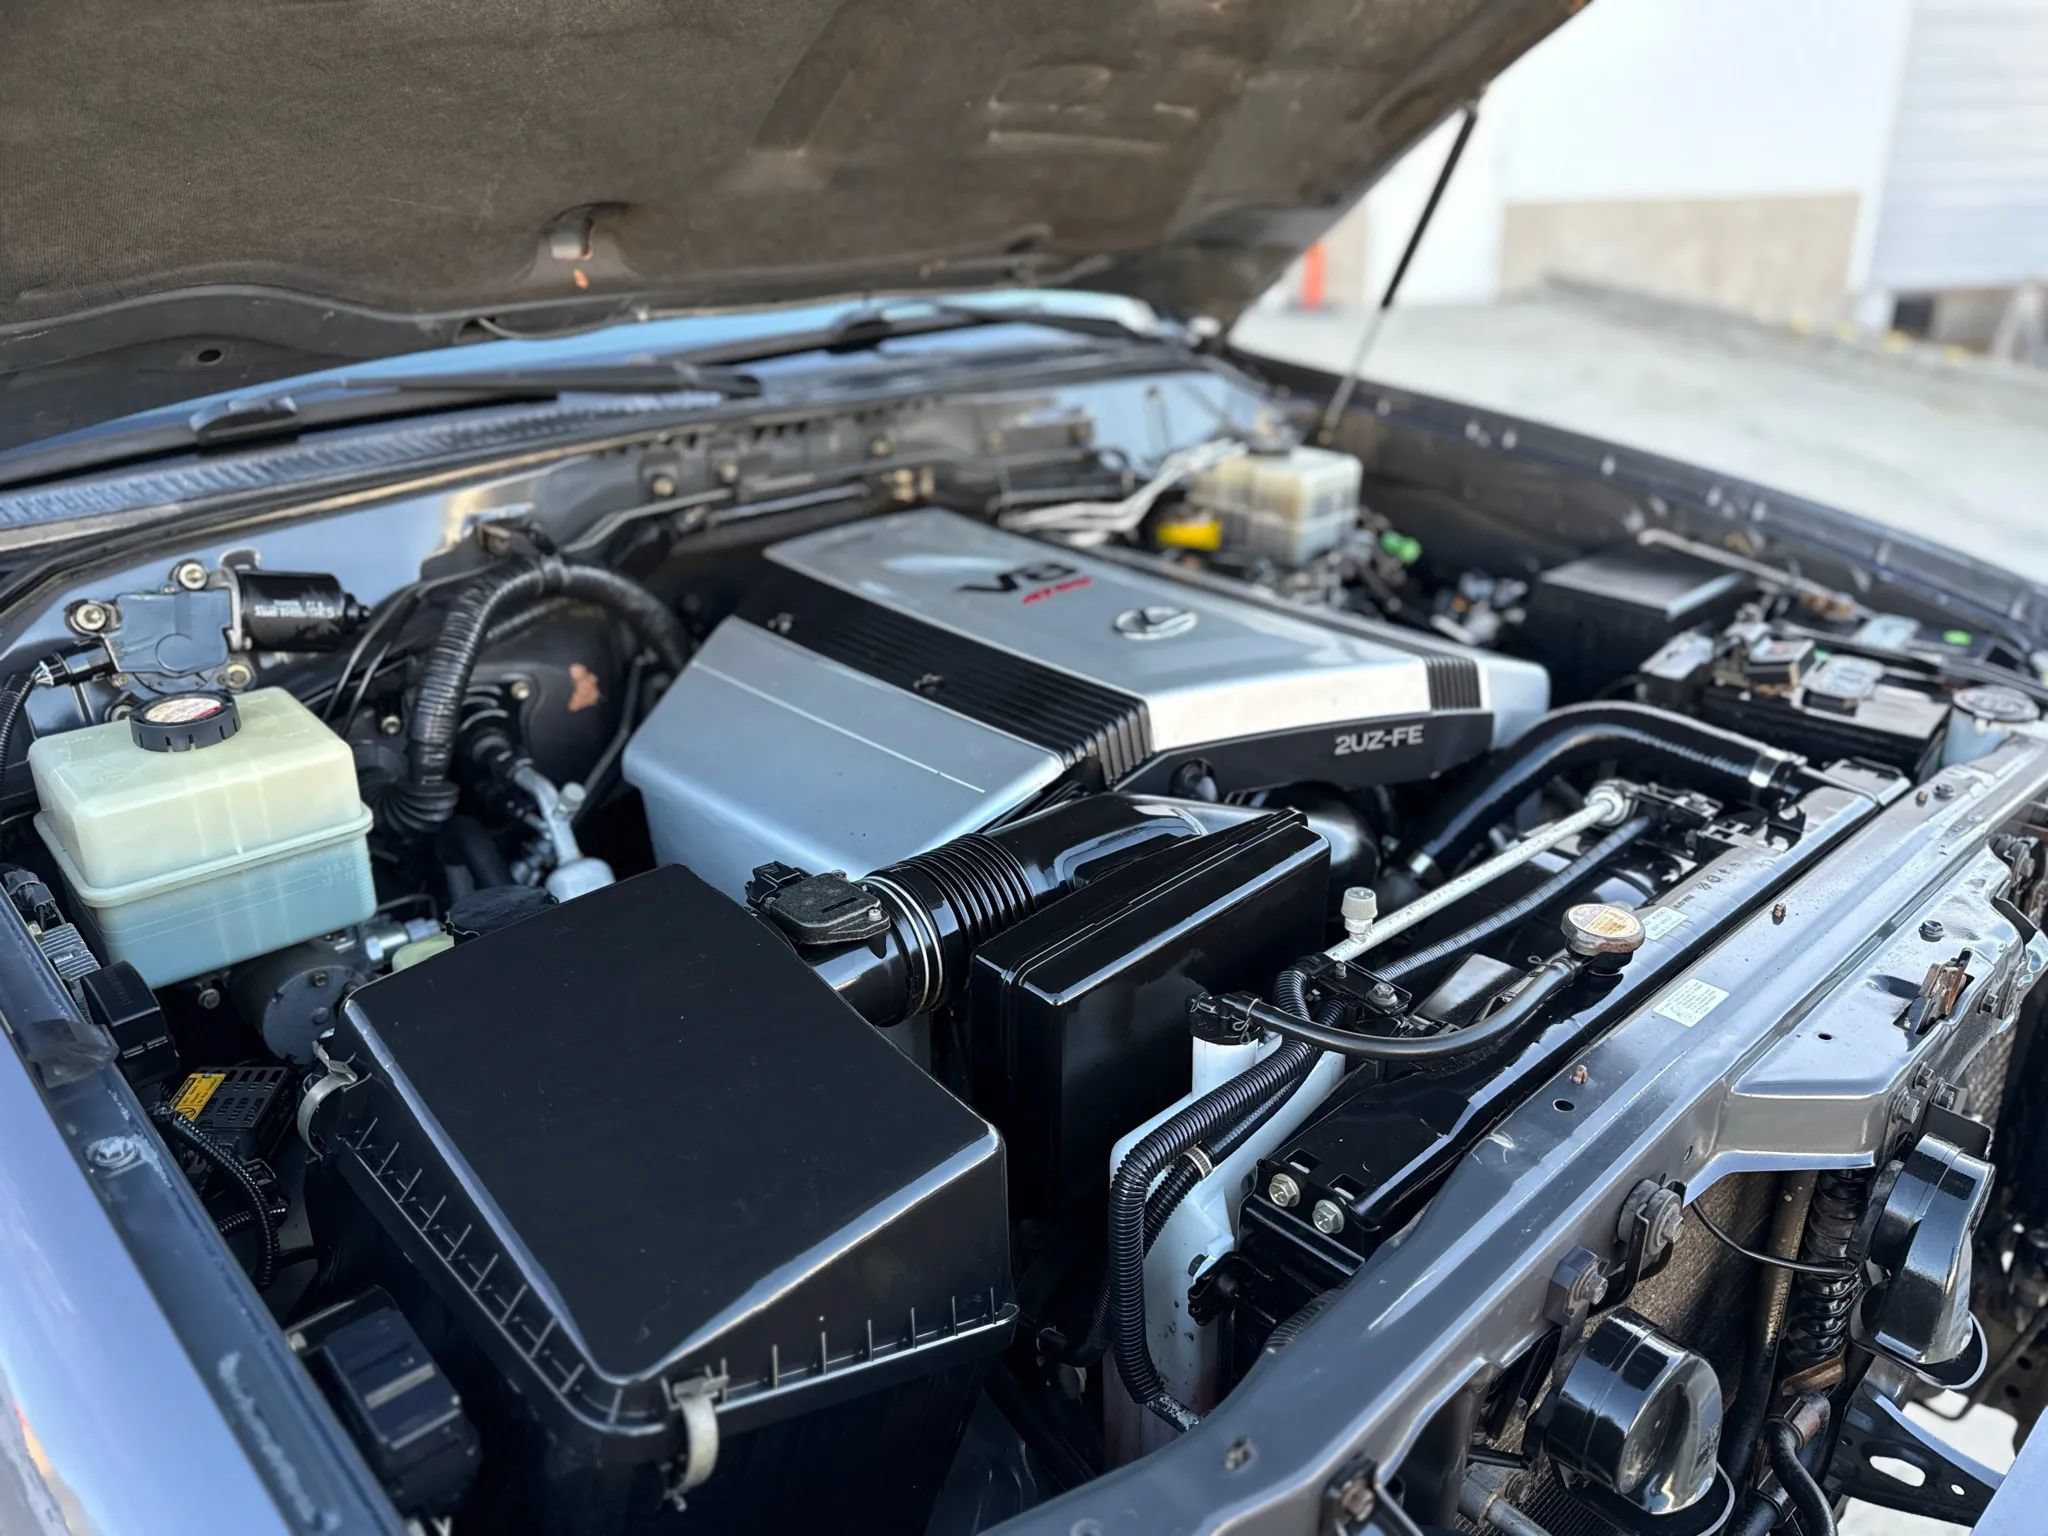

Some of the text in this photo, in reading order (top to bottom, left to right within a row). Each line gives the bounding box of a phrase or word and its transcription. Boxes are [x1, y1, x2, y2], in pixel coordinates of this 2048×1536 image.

[956, 562, 1078, 593] V8
[1334, 724, 1424, 755] 2UZ-FE
[319, 860, 353, 877] MAX
